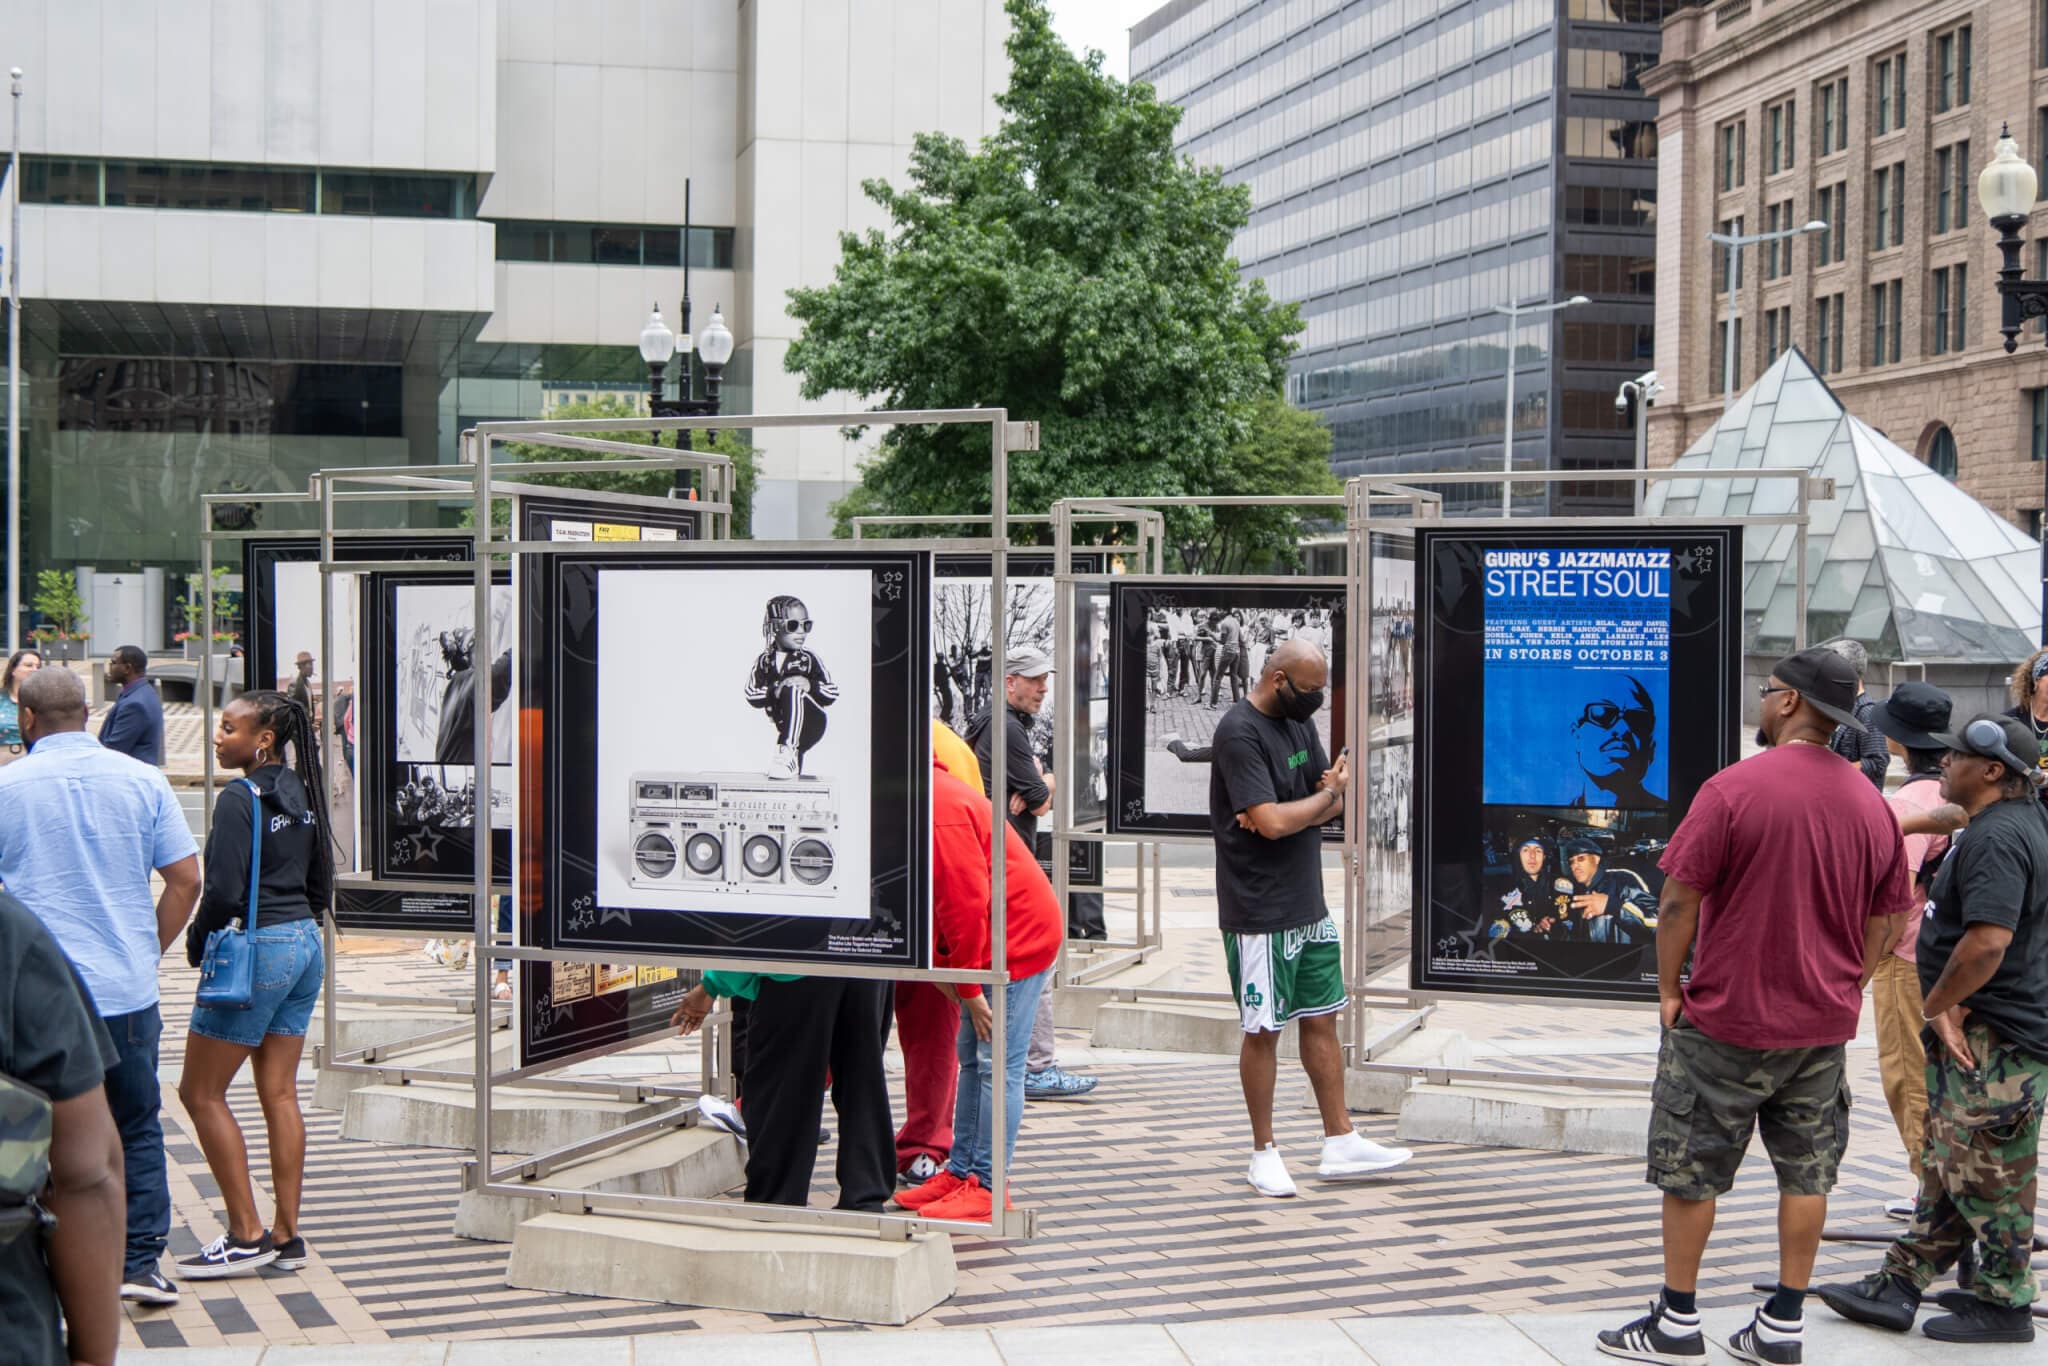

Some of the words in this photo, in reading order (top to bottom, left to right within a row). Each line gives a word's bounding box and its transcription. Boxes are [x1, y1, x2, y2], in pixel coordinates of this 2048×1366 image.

[1485, 552, 1550, 568] GURU'S
[1557, 552, 1670, 569] JAZZMATAZZ
[1486, 569, 1670, 597] STREETSOUL
[1485, 648, 1503, 659] IN
[1509, 648, 1572, 660] STORES
[1578, 649, 1654, 661] OCTOBER
[1660, 650, 1668, 661] 3
